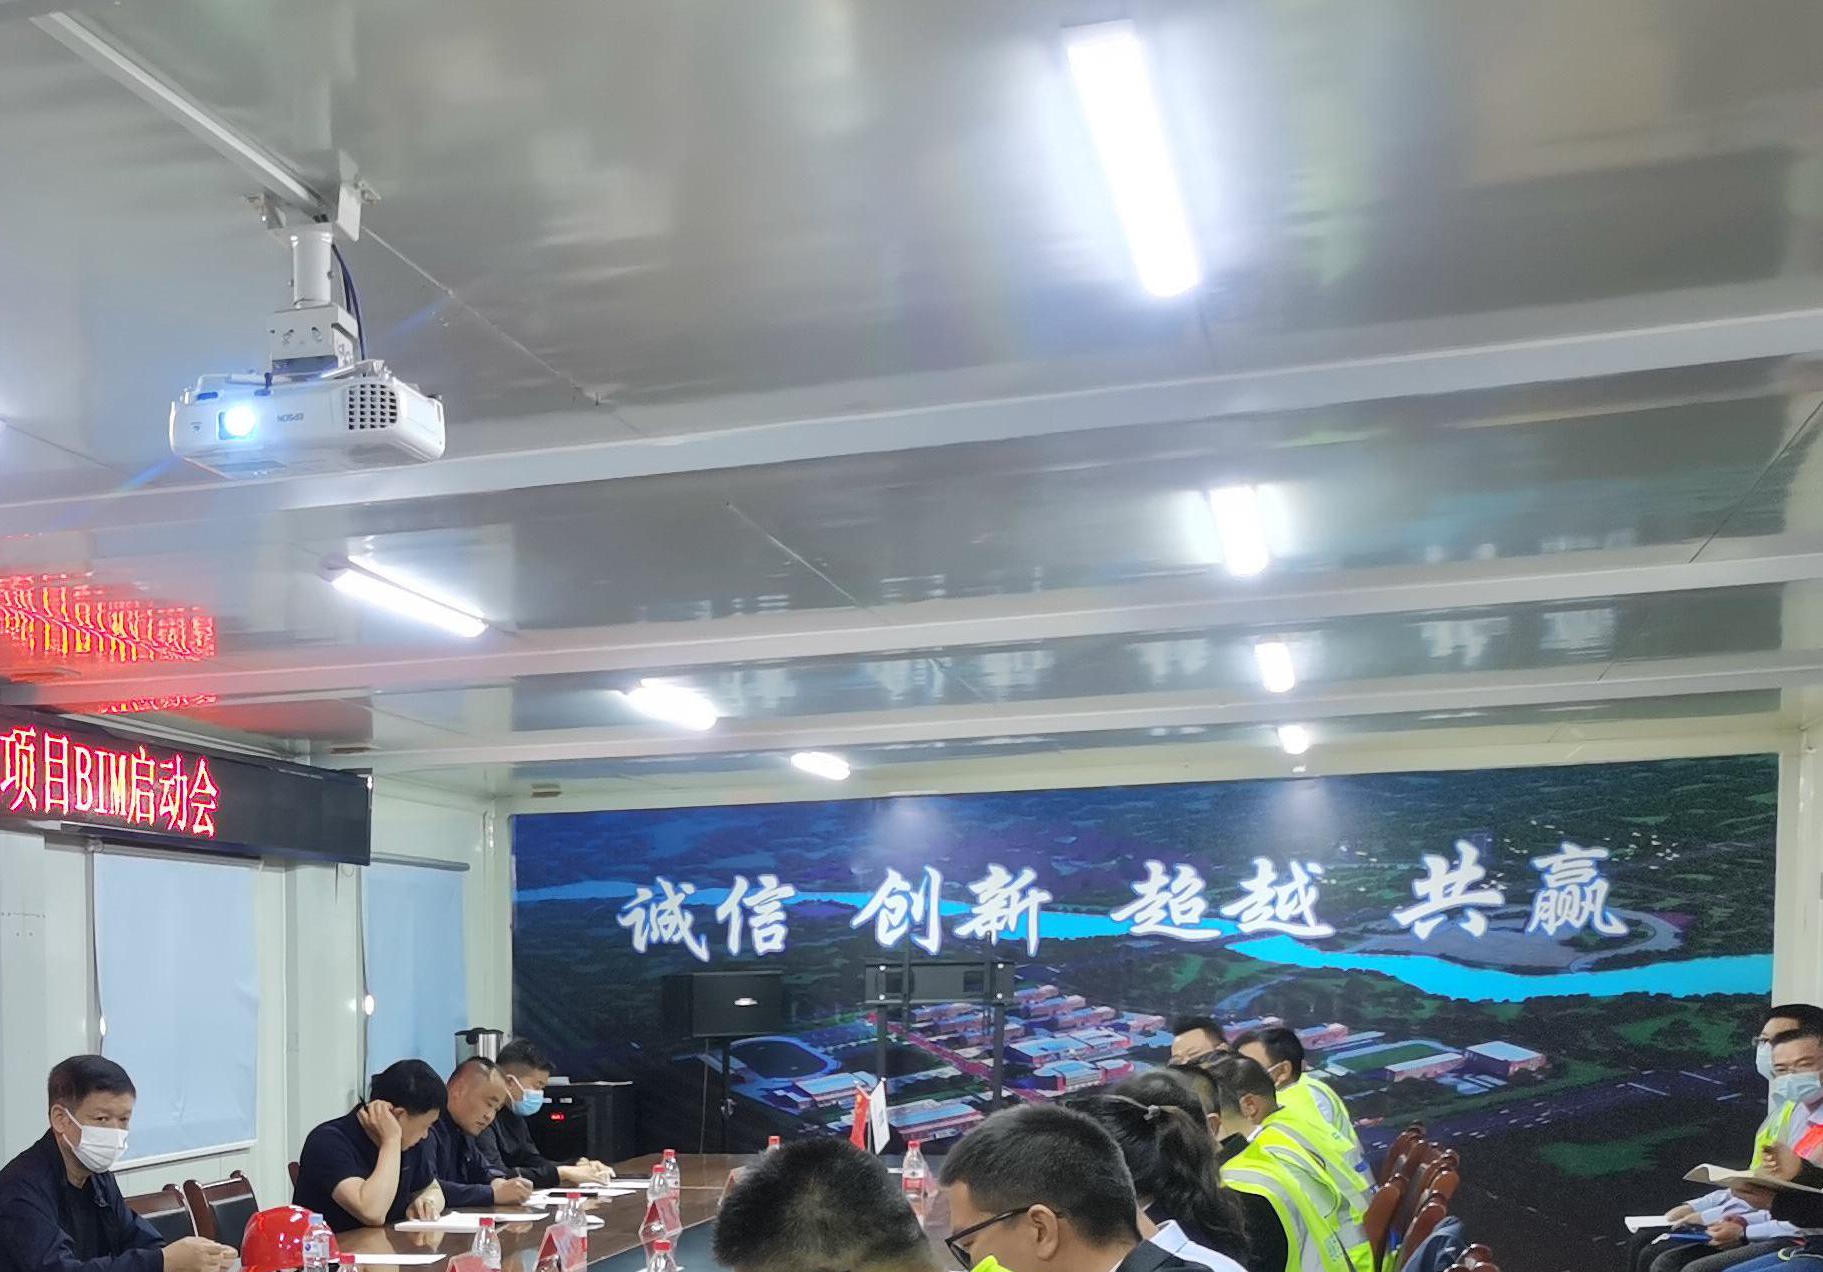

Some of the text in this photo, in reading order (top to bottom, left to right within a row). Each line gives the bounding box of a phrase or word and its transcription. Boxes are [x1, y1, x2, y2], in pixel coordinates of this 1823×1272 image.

[617, 840, 1631, 959] 诚信 创新 超越 共赢
